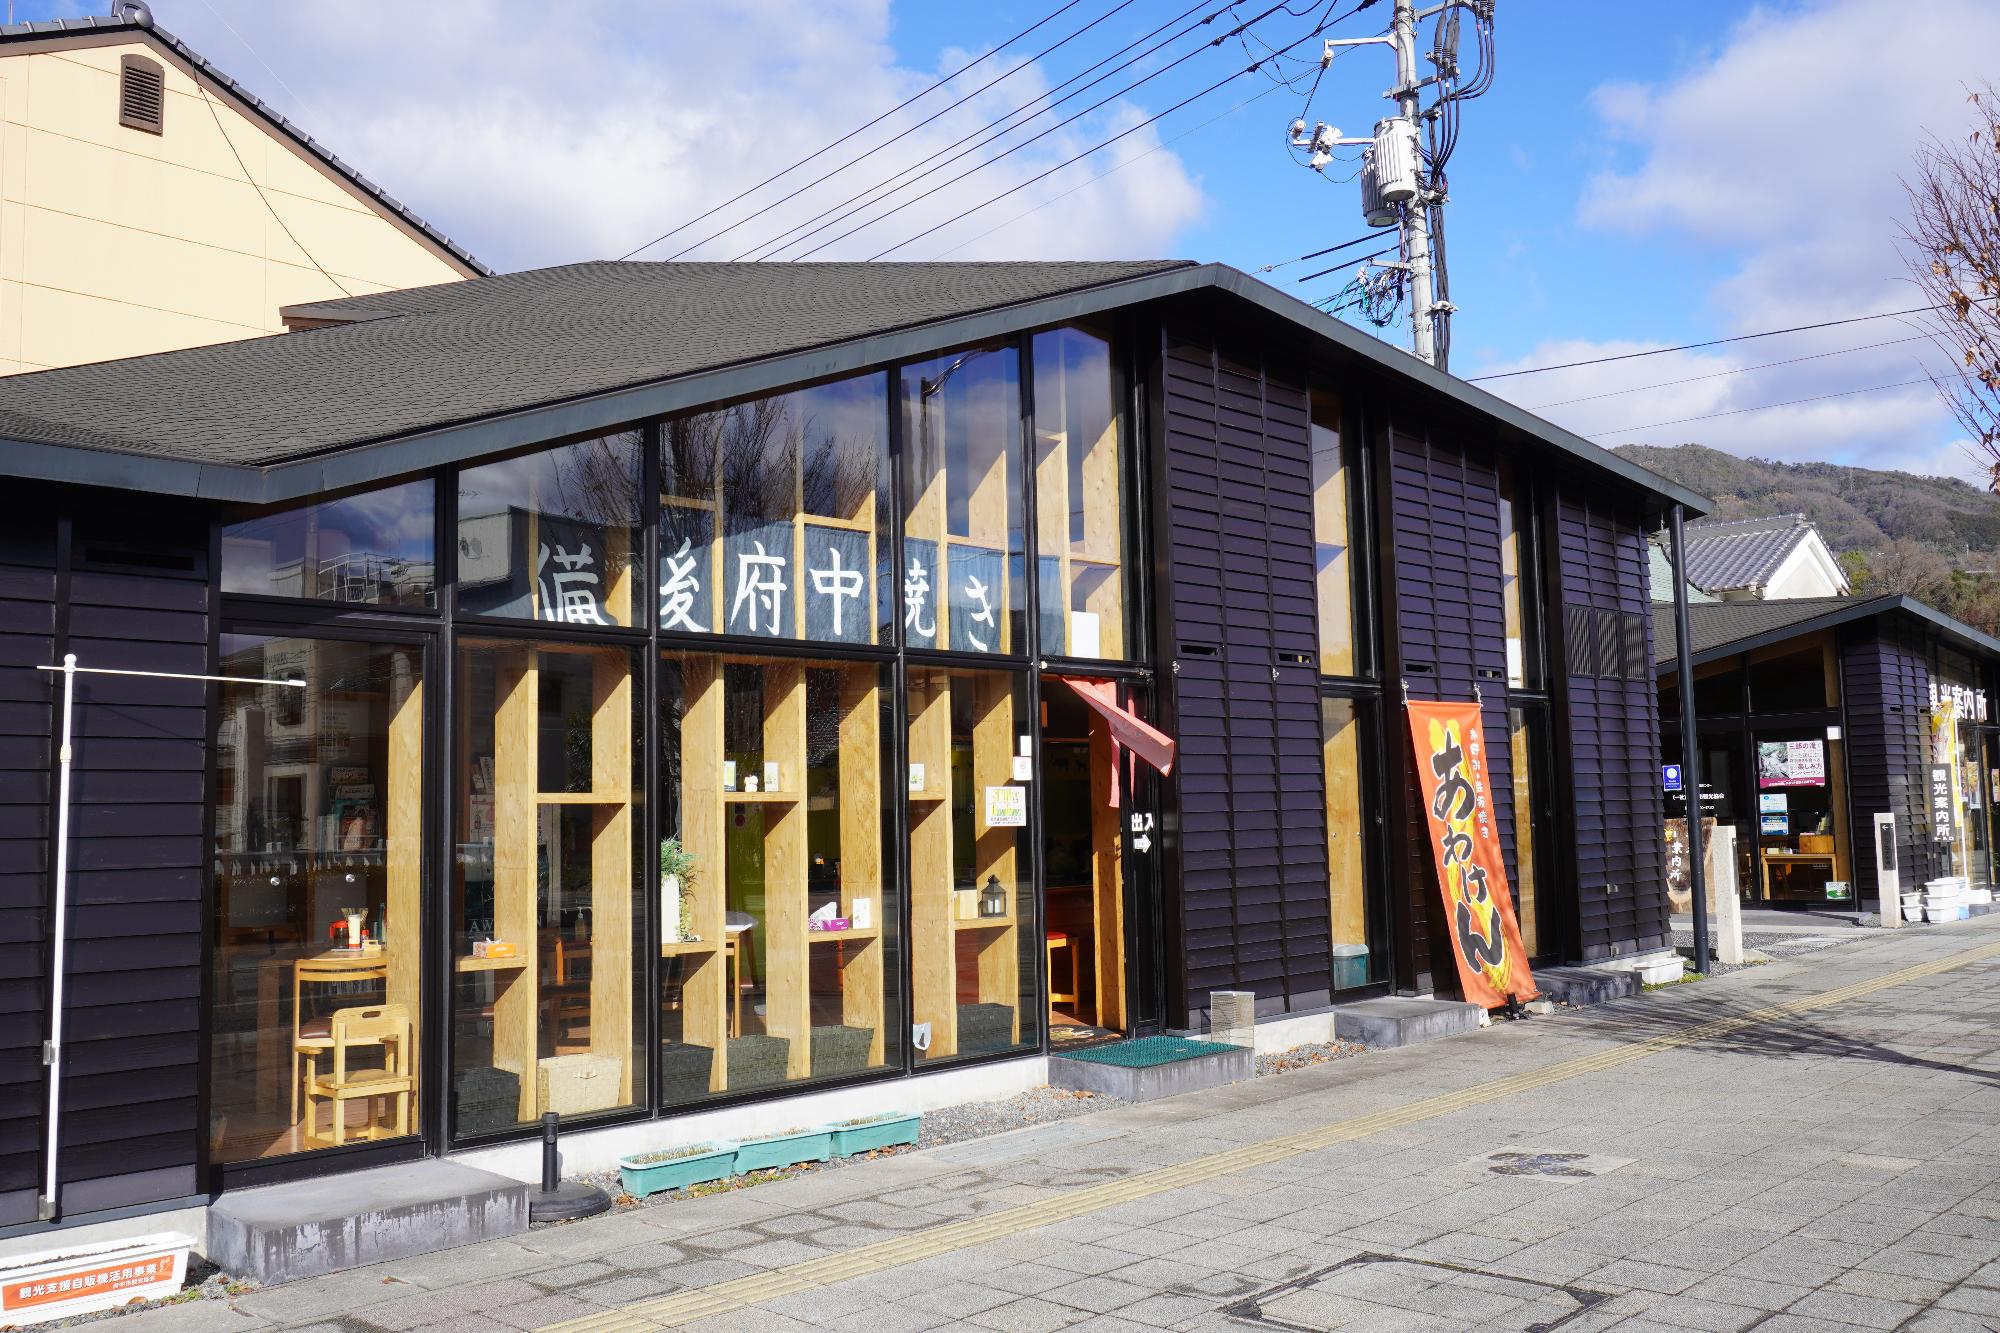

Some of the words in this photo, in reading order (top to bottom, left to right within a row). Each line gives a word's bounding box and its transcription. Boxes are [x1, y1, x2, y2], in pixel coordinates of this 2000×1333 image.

[1932, 769, 1951, 837] 観光案内所
[1431, 728, 1503, 974] あわけん
[19, 1263, 157, 1299] 観光支援自販機活用事業
